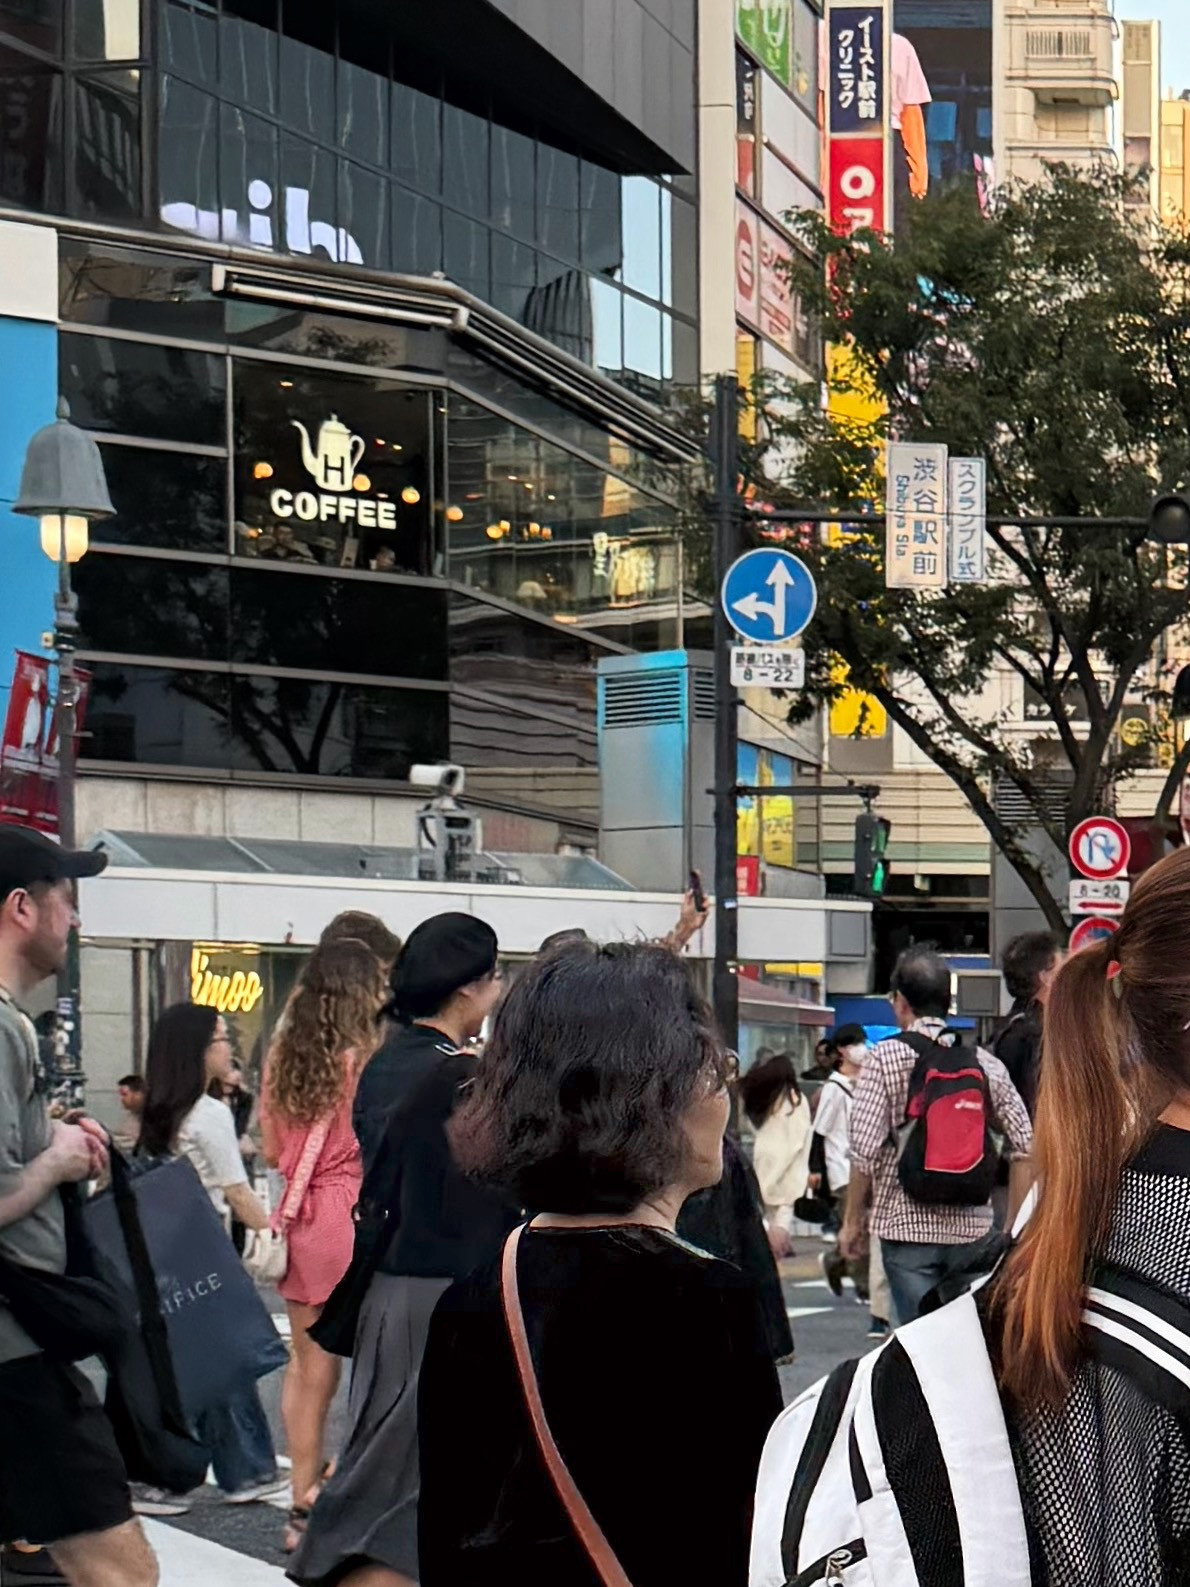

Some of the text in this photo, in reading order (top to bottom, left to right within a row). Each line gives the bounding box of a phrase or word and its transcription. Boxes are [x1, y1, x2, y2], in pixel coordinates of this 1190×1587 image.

[837, 29, 854, 109] クリニック
[857, 15, 876, 119] イースト駅前
[270, 488, 397, 530] COFFEE
[913, 457, 938, 575] 渋谷駅前
[957, 463, 976, 576] スクランブル式
